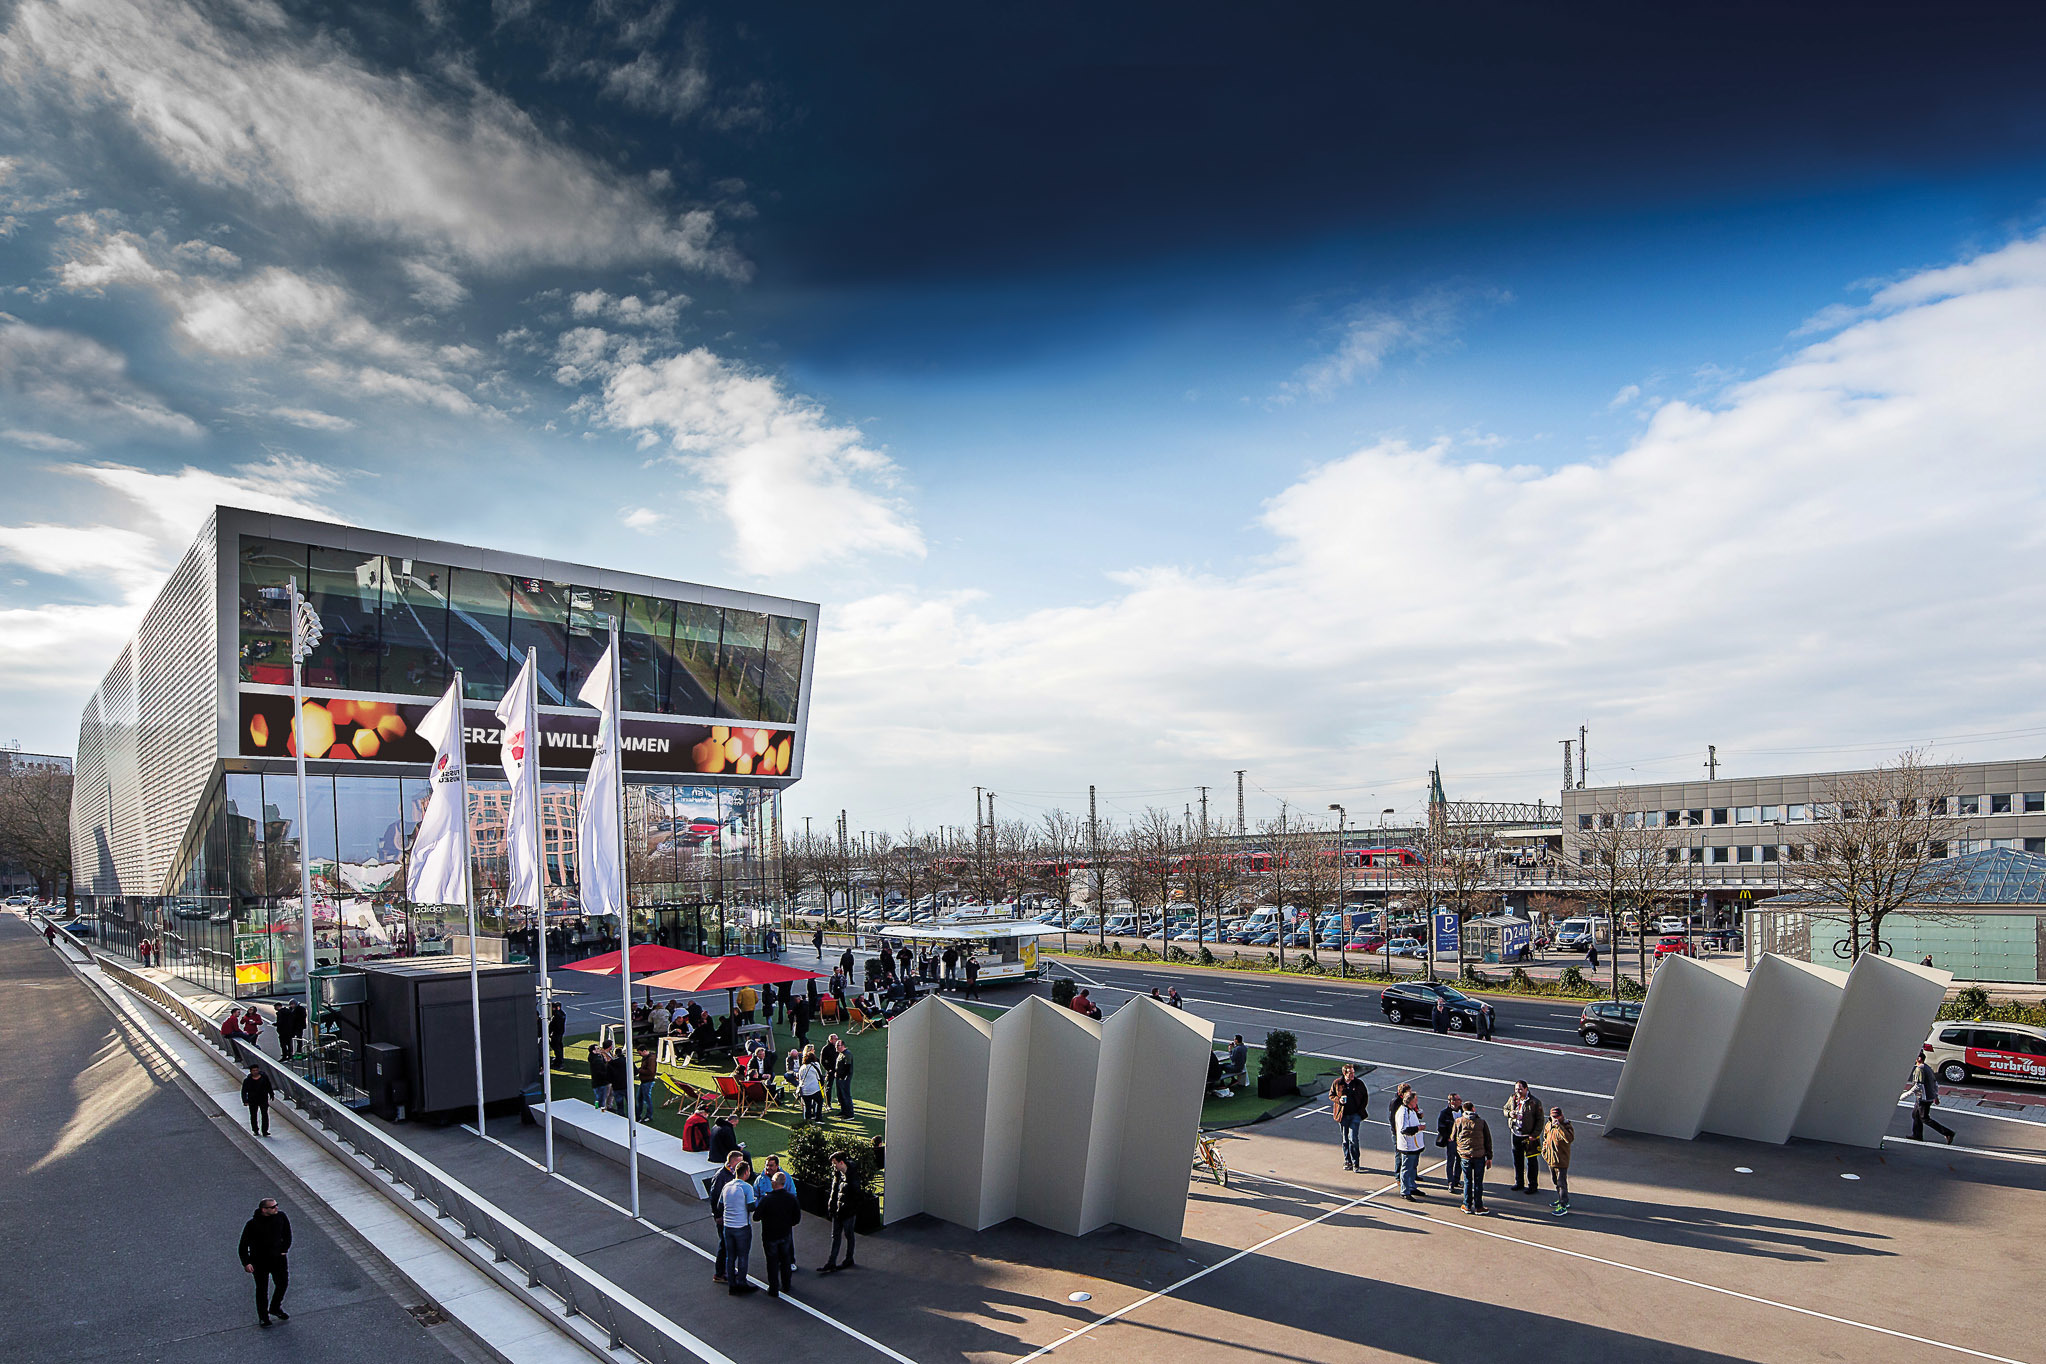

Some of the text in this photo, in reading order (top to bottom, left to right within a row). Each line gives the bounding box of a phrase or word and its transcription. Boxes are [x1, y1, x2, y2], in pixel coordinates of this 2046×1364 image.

[546, 732, 670, 753] WILLMMEN
[414, 905, 447, 913] adidas
[1445, 916, 1453, 929] P
[1503, 924, 1528, 955] P 24h
